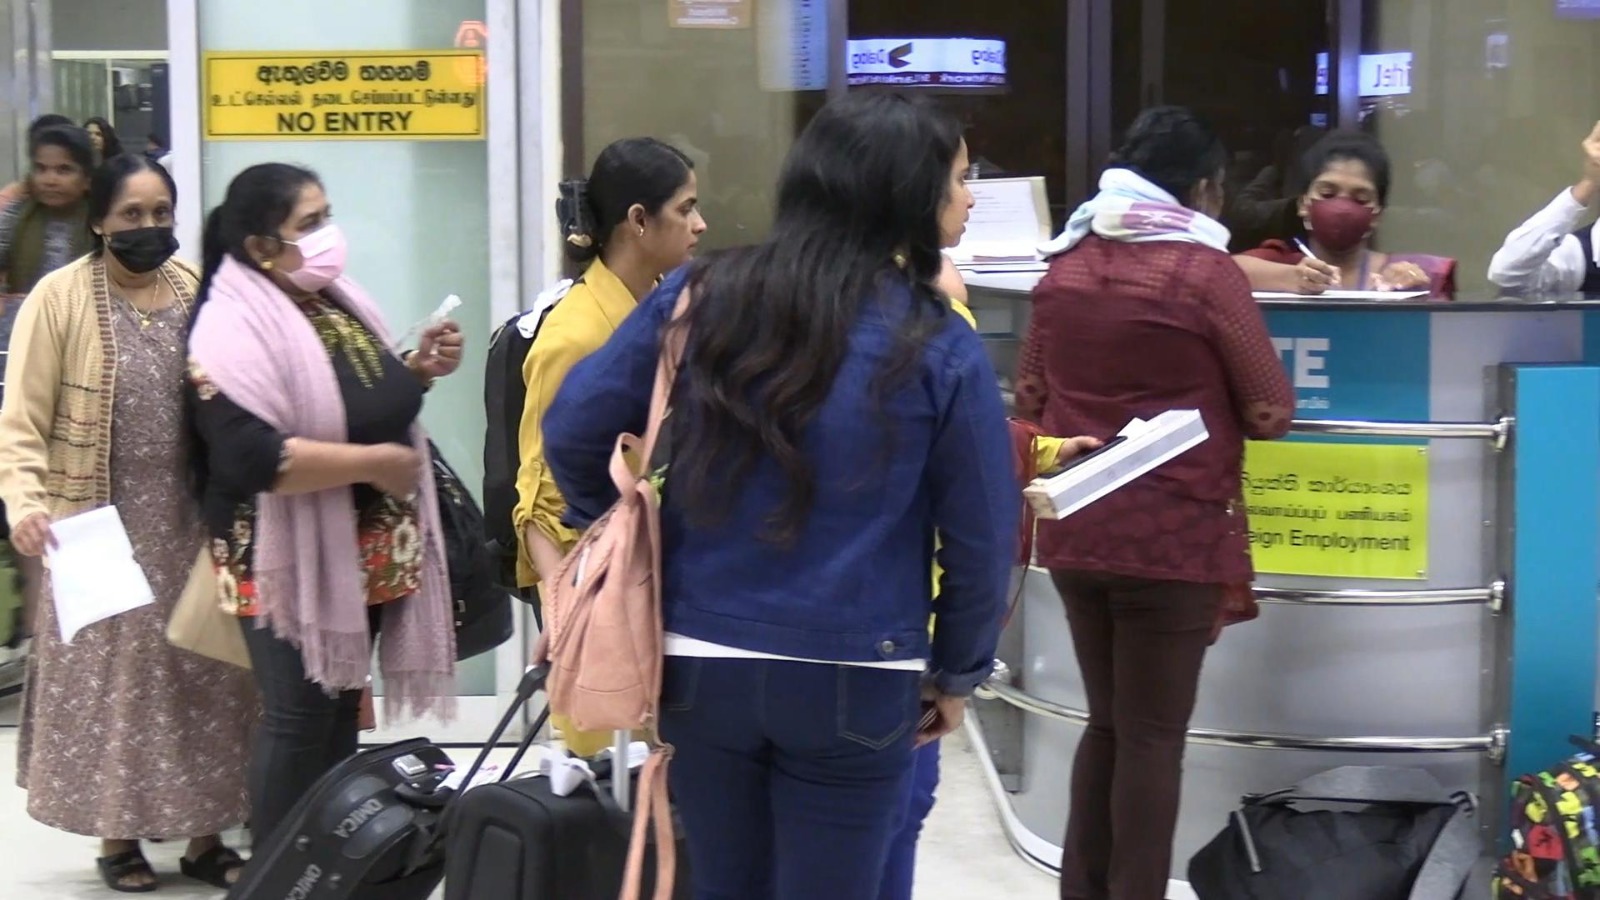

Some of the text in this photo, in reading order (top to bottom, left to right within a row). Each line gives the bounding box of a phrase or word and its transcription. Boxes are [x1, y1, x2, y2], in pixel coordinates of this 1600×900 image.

[277, 111, 413, 132] NO ENTRY
[1246, 528, 1411, 553] eign Employment
